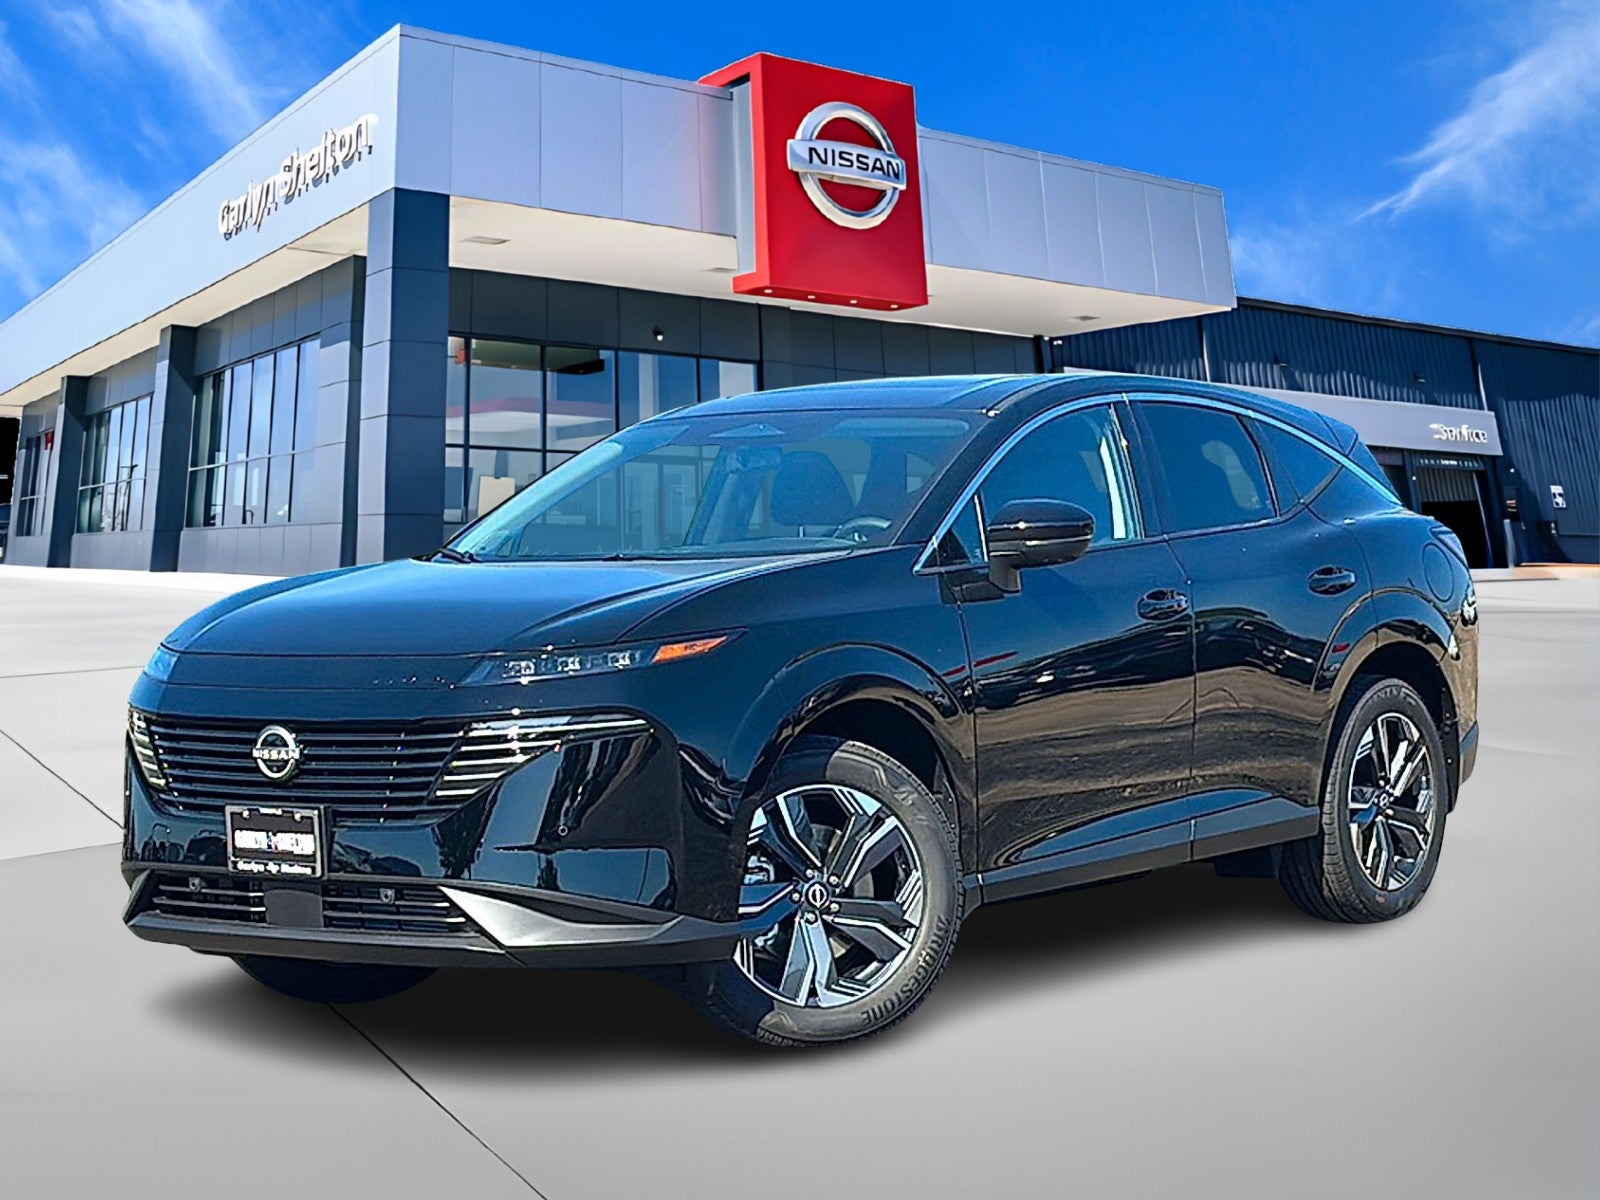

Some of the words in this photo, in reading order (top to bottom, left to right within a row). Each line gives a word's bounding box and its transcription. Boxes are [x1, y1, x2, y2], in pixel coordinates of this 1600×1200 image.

[279, 119, 374, 202] Shelton
[808, 147, 900, 180] NISSAN
[253, 747, 300, 760] NISSAN
[861, 914, 951, 1025] BRIDGESTONE
